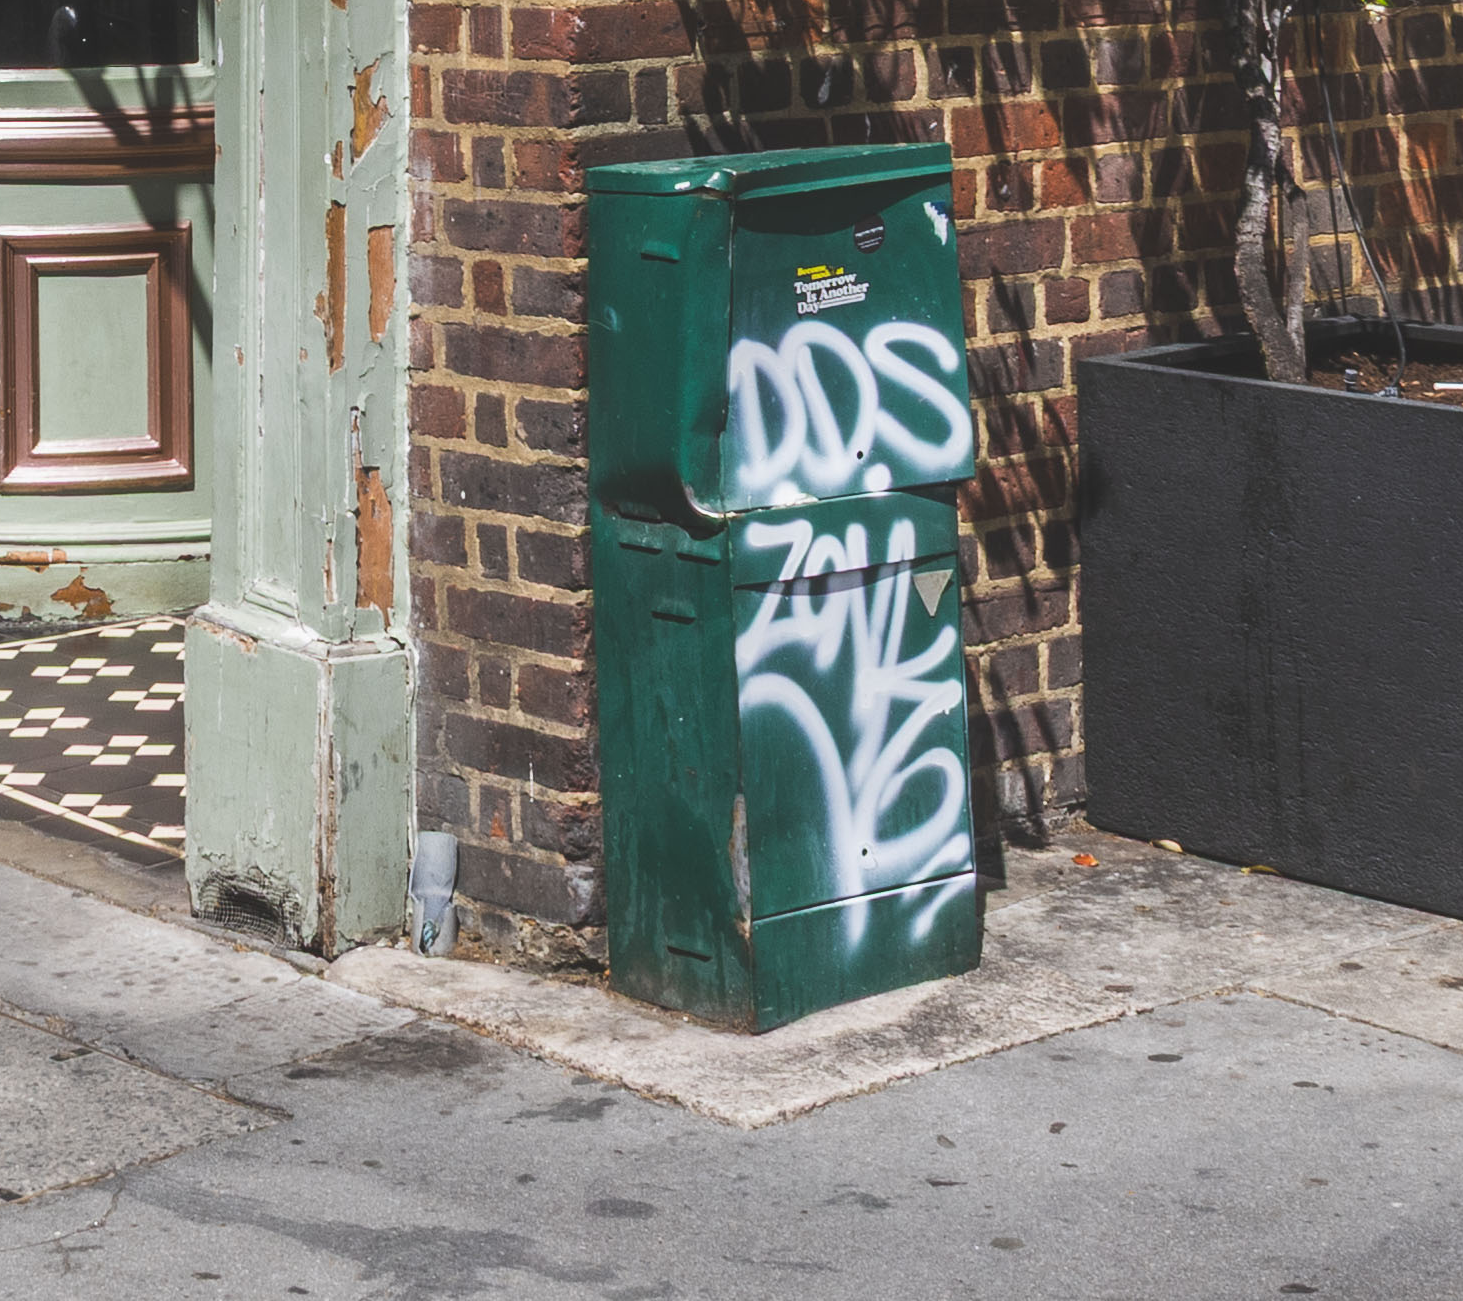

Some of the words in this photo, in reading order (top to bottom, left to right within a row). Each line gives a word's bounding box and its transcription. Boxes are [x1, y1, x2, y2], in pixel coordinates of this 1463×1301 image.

[794, 273, 858, 294] Tomorrow
[806, 291, 817, 304] Is
[819, 282, 870, 301] Another
[797, 302, 819, 315] Day
